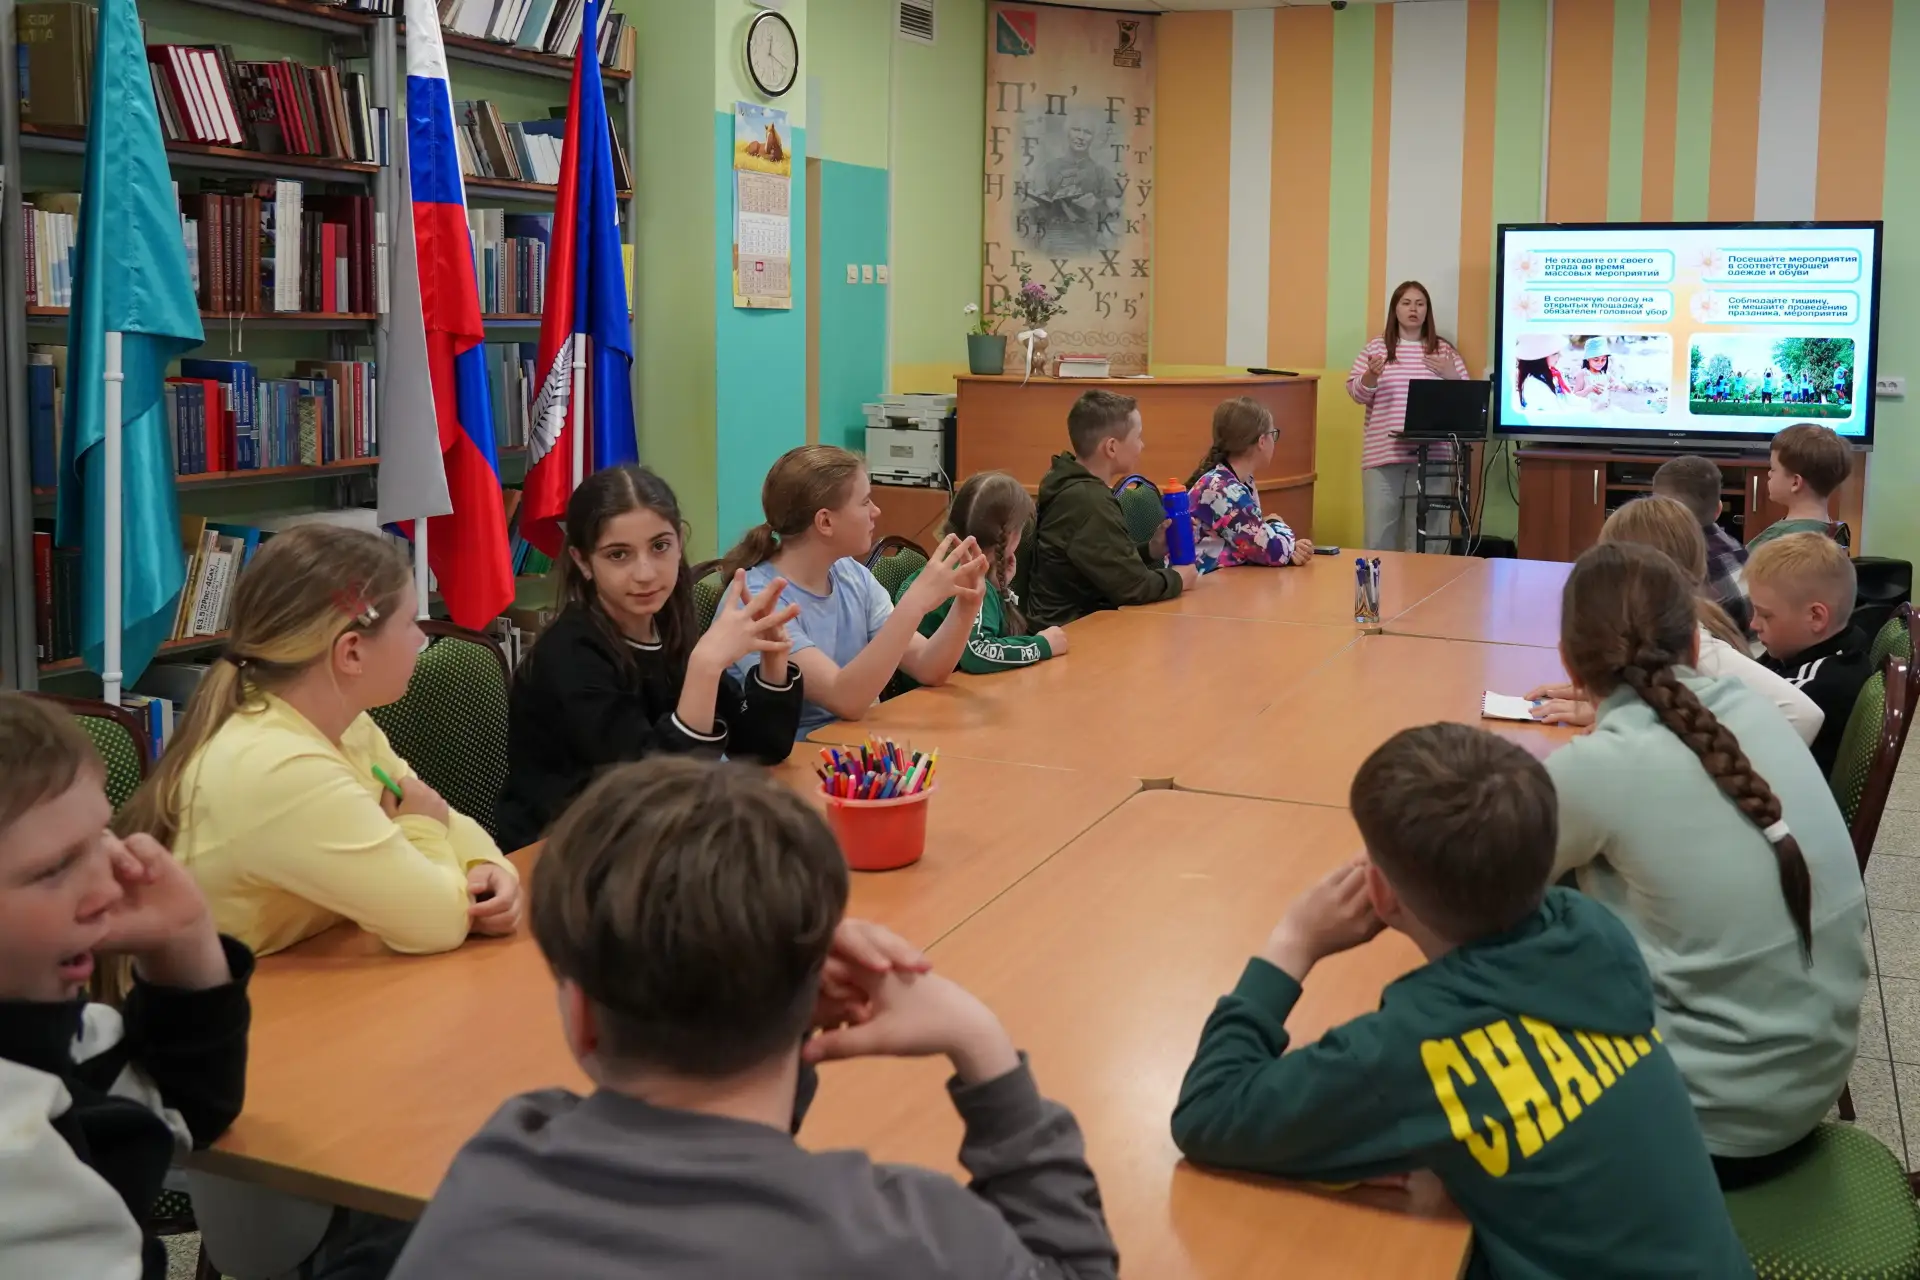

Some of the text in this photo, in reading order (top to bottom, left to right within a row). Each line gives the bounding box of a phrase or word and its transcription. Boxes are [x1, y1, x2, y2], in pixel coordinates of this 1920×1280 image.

[1788, 255, 1858, 264] мероприятия
[1544, 263, 1578, 271] отряда
[1595, 270, 1660, 278] мероприятий
[1727, 269, 1766, 277] одежде
[1778, 269, 1809, 277] обуви
[1553, 296, 1604, 304] солнечную
[1543, 307, 1597, 315] обязателен
[1783, 310, 1848, 318] мероприятия
[1420, 1015, 1663, 1178] CHAM
